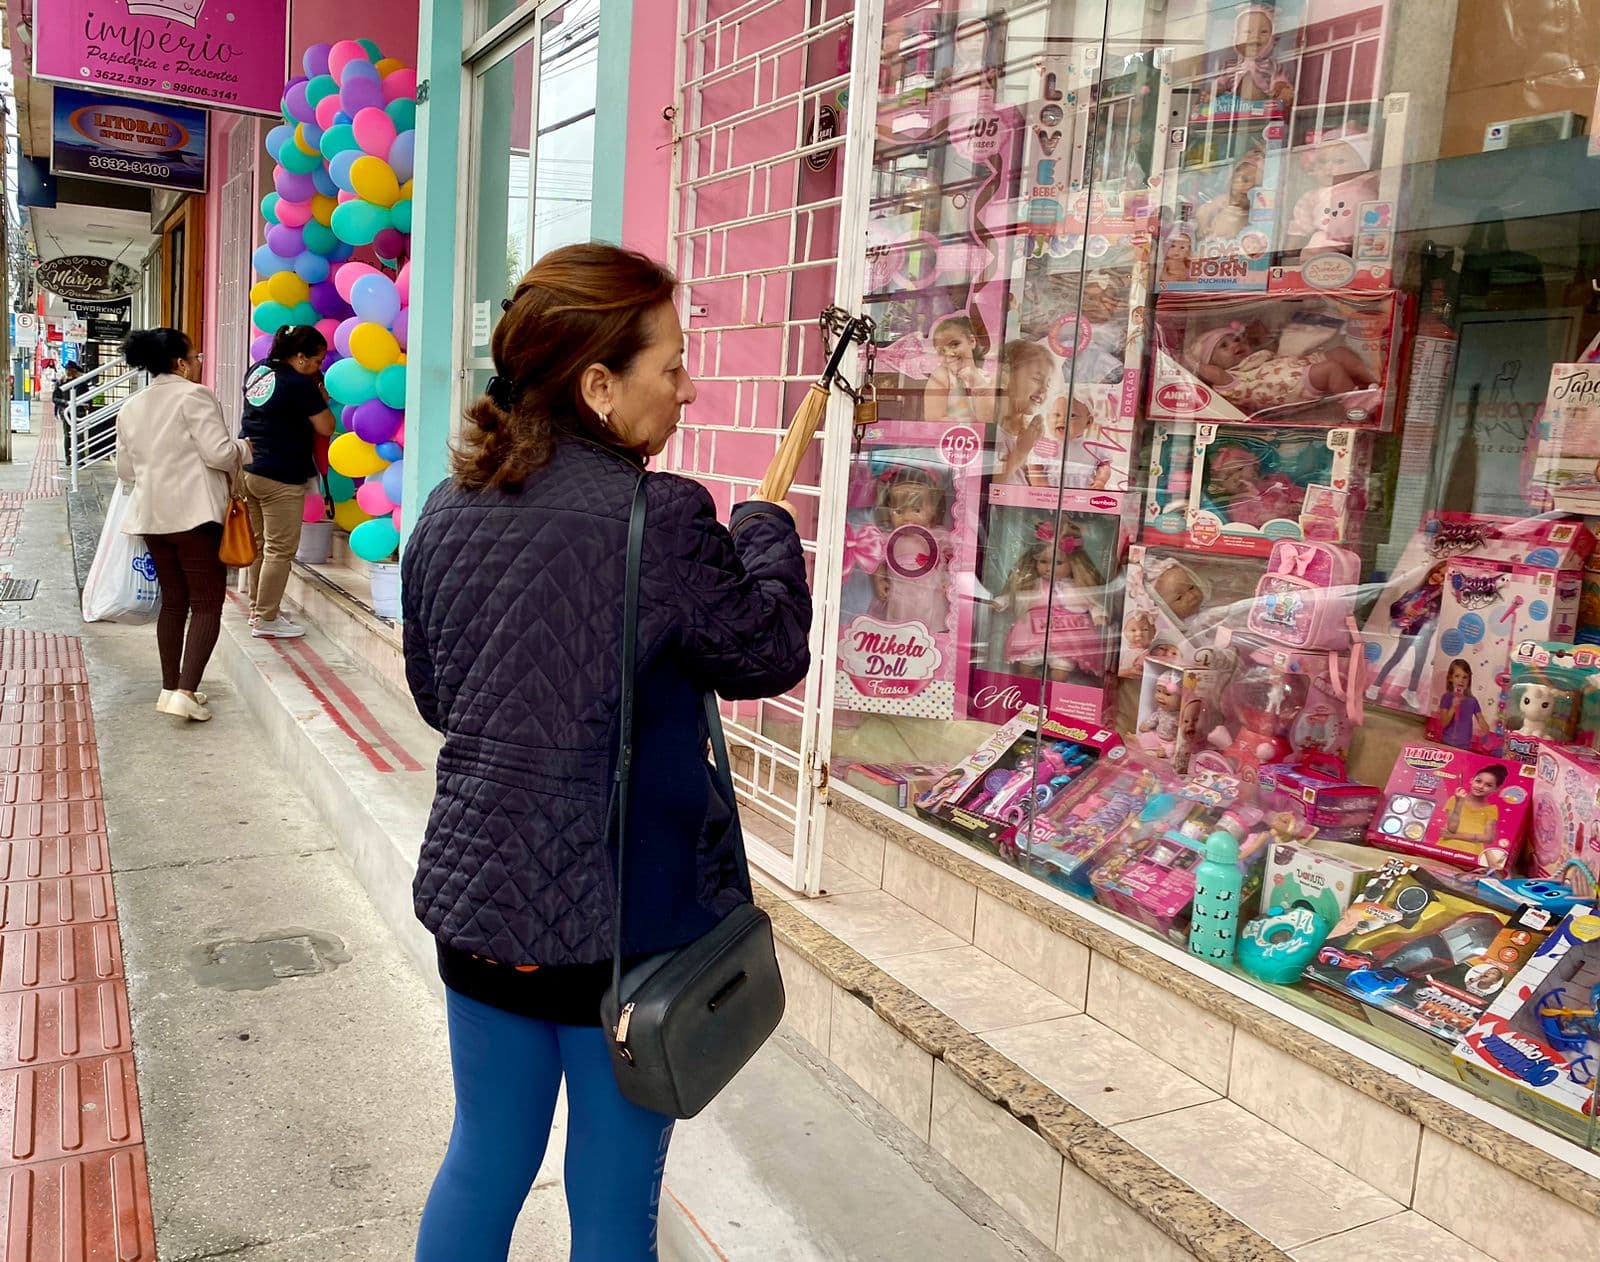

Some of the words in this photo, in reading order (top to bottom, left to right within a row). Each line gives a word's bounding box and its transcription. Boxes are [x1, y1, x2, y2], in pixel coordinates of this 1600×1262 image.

[85, 12, 243, 66] império
[87, 45, 157, 70] Papelaria
[163, 63, 170, 71] e
[176, 61, 239, 83] Presentes
[94, 69, 157, 87] 3622.5397
[172, 82, 238, 101] 99606.3141
[89, 155, 170, 178] 3632-3400
[1189, 259, 1247, 277] BORN
[47, 269, 103, 292] Mariza
[22, 316, 28, 325] E
[69, 304, 123, 314] COWORKING
[1124, 370, 1137, 414] ORAÇÃO
[945, 434, 976, 451] 105
[853, 631, 928, 658] Mikela
[865, 656, 908, 677] Doll
[867, 679, 910, 696] Frases
